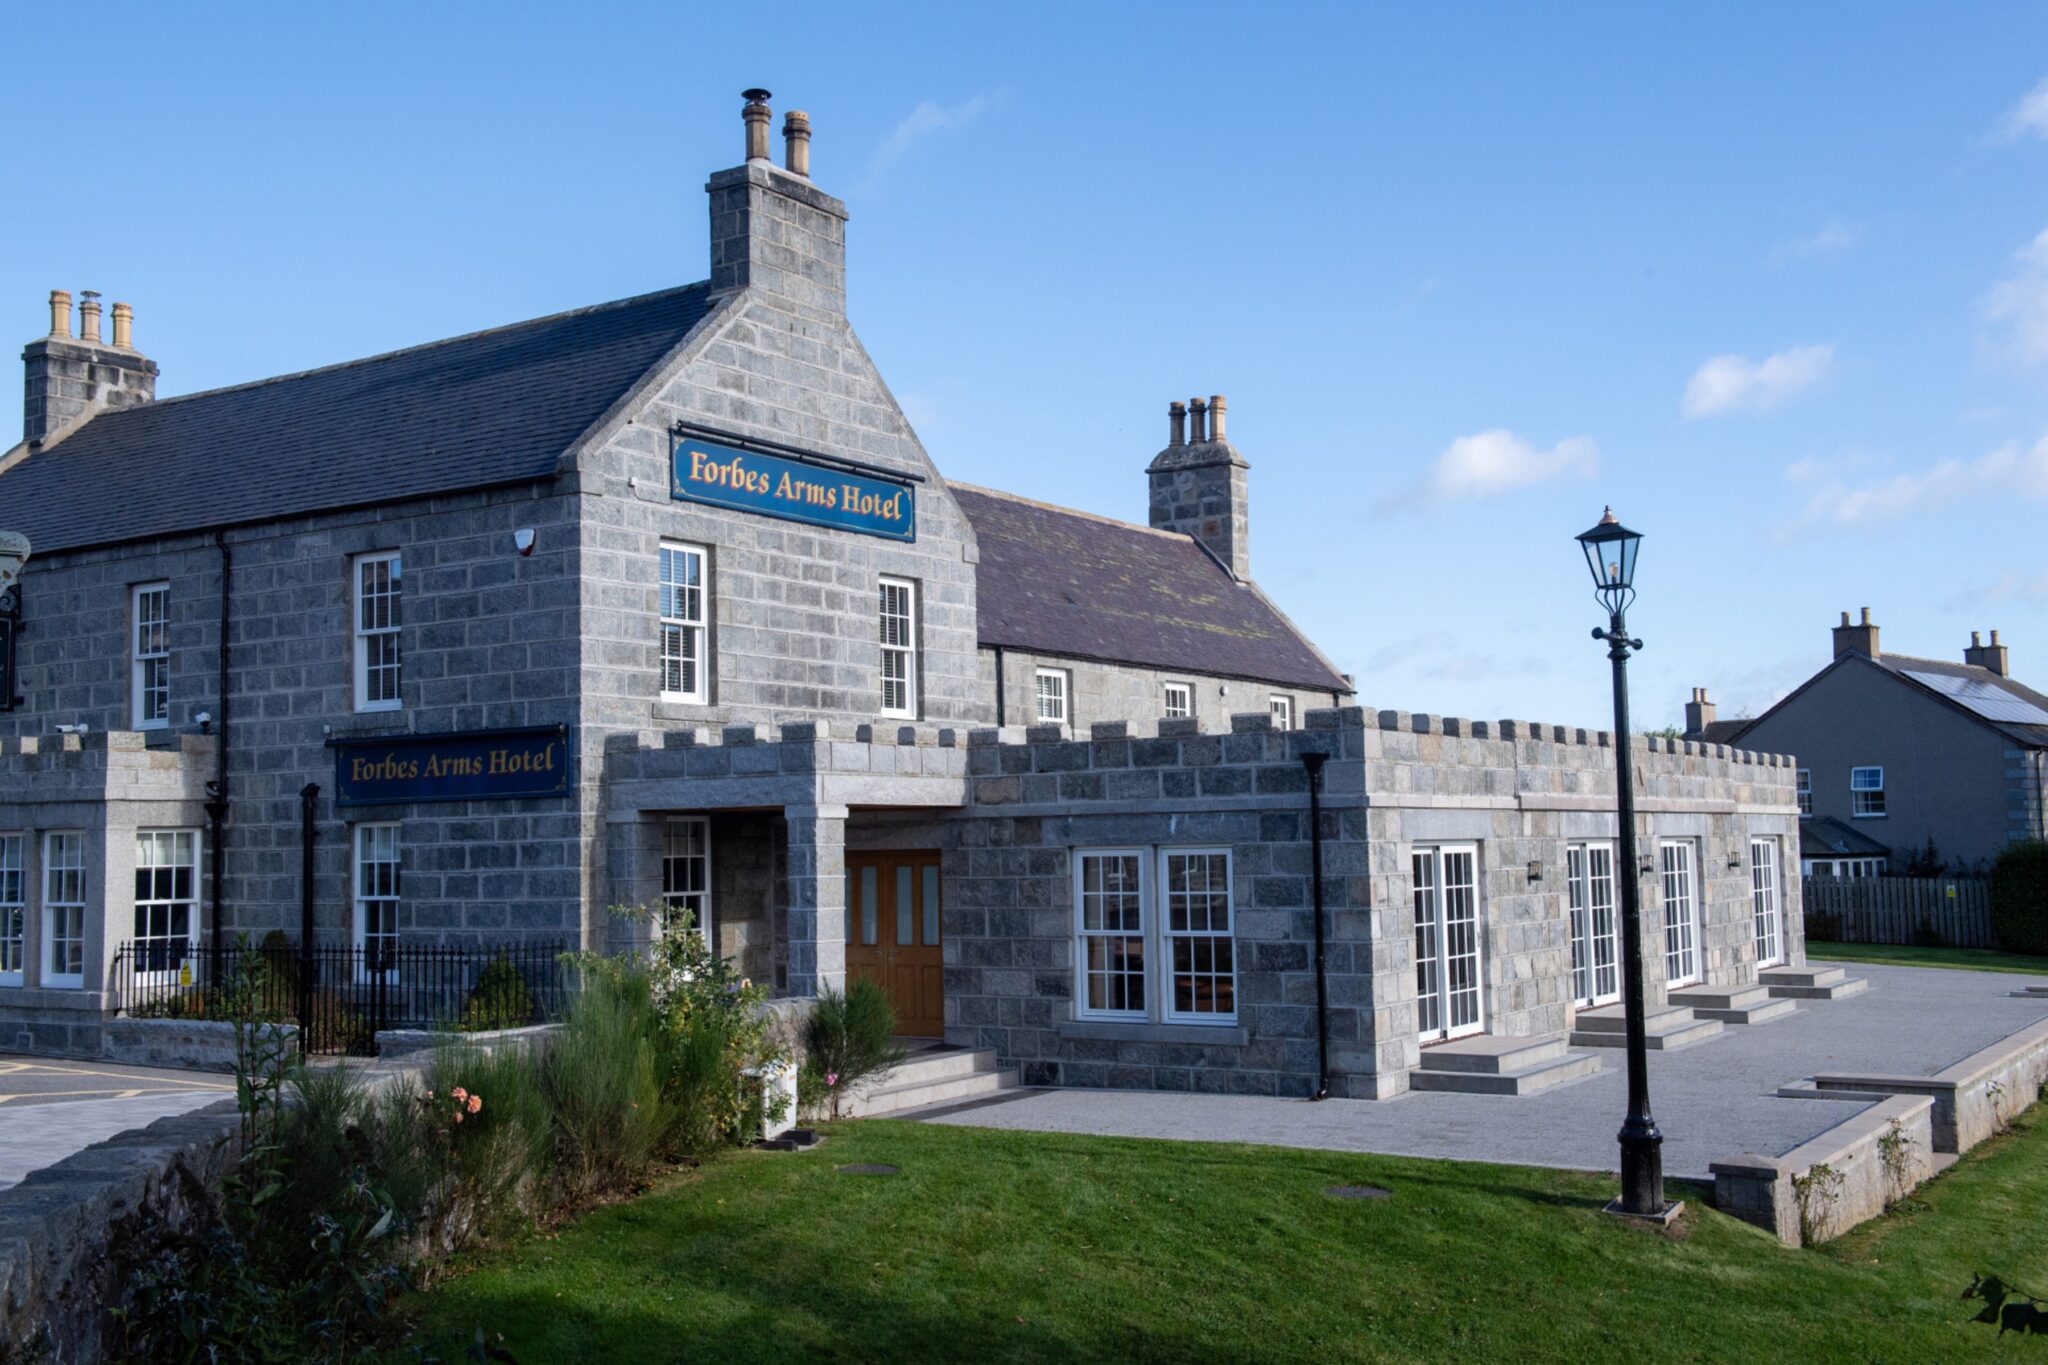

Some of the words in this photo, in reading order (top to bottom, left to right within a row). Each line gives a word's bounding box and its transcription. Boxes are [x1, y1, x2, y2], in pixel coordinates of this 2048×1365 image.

[688, 451, 770, 494] Forbes
[774, 471, 837, 509] Arms
[841, 484, 902, 520] Hotel
[351, 752, 419, 782] Forbes
[423, 753, 482, 778] Arms
[488, 742, 555, 775] Hotel
